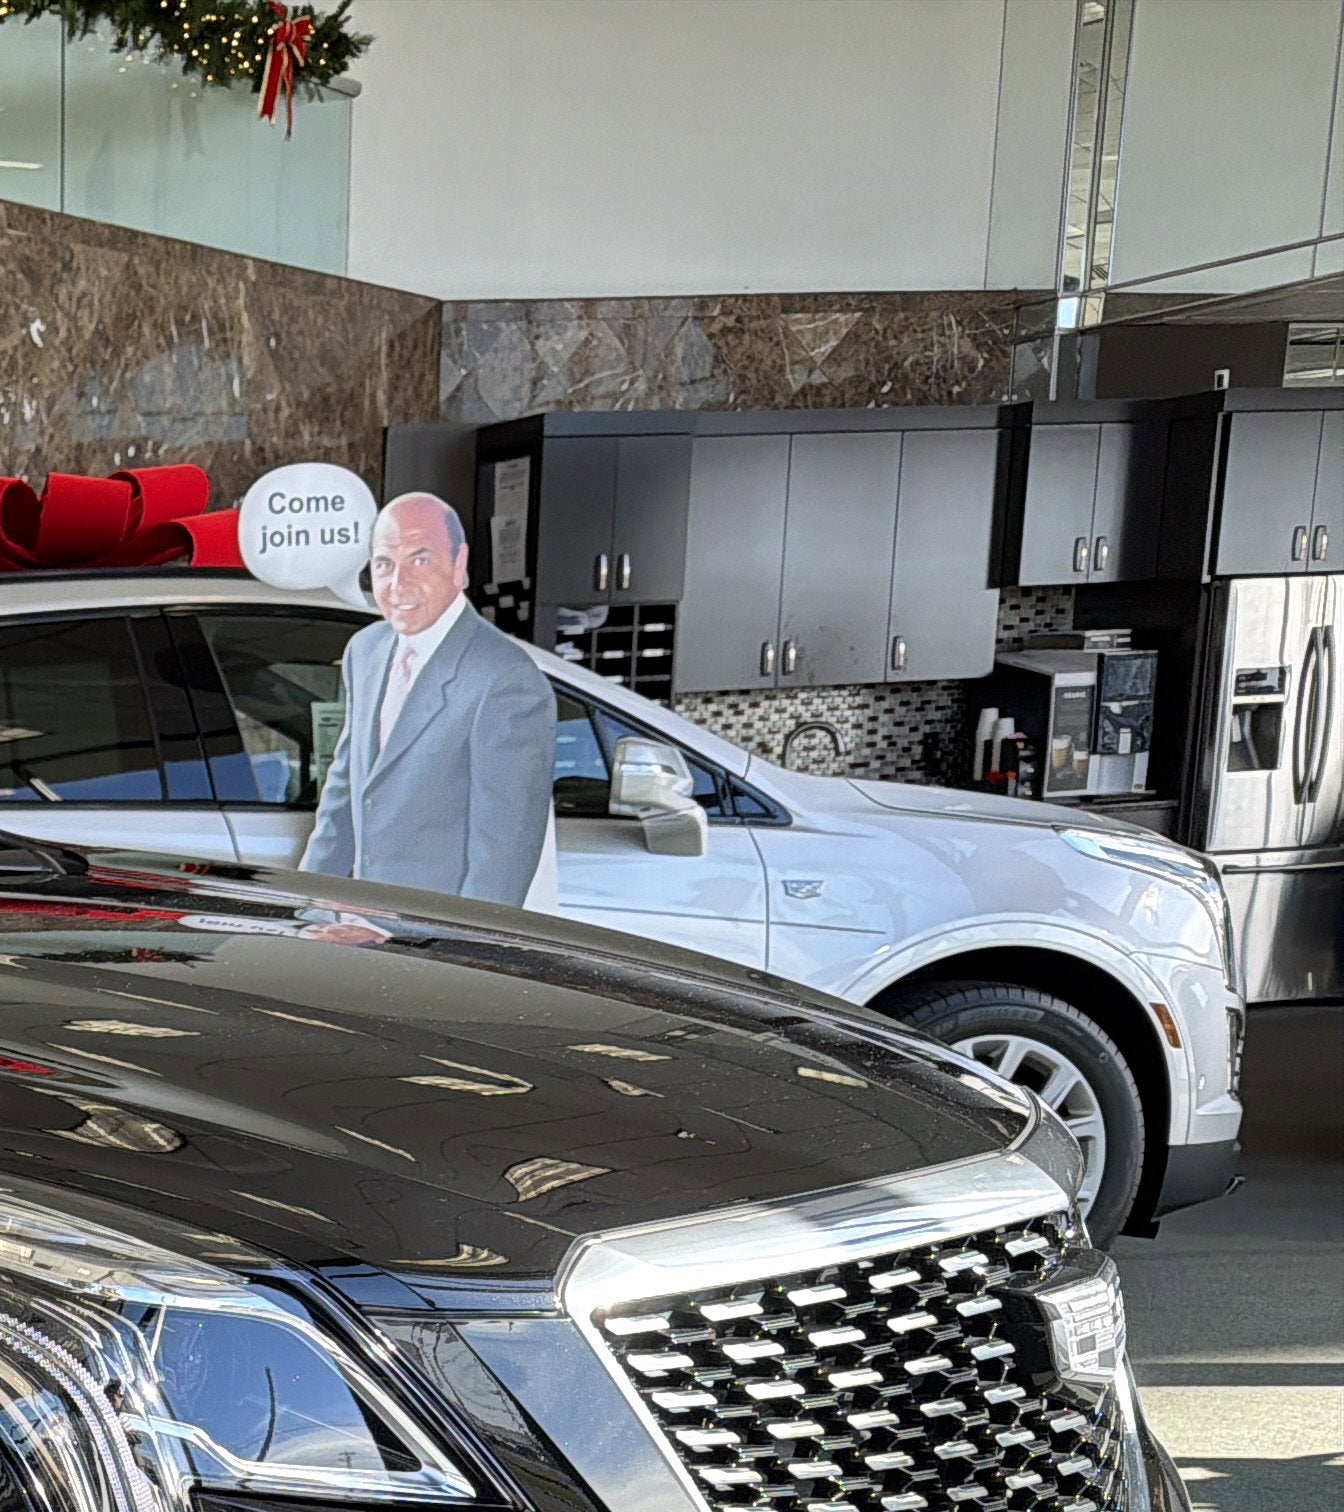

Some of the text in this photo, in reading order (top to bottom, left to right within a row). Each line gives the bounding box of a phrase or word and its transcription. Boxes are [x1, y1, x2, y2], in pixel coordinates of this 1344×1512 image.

[268, 491, 346, 515] Come
[259, 521, 361, 554] join us!
